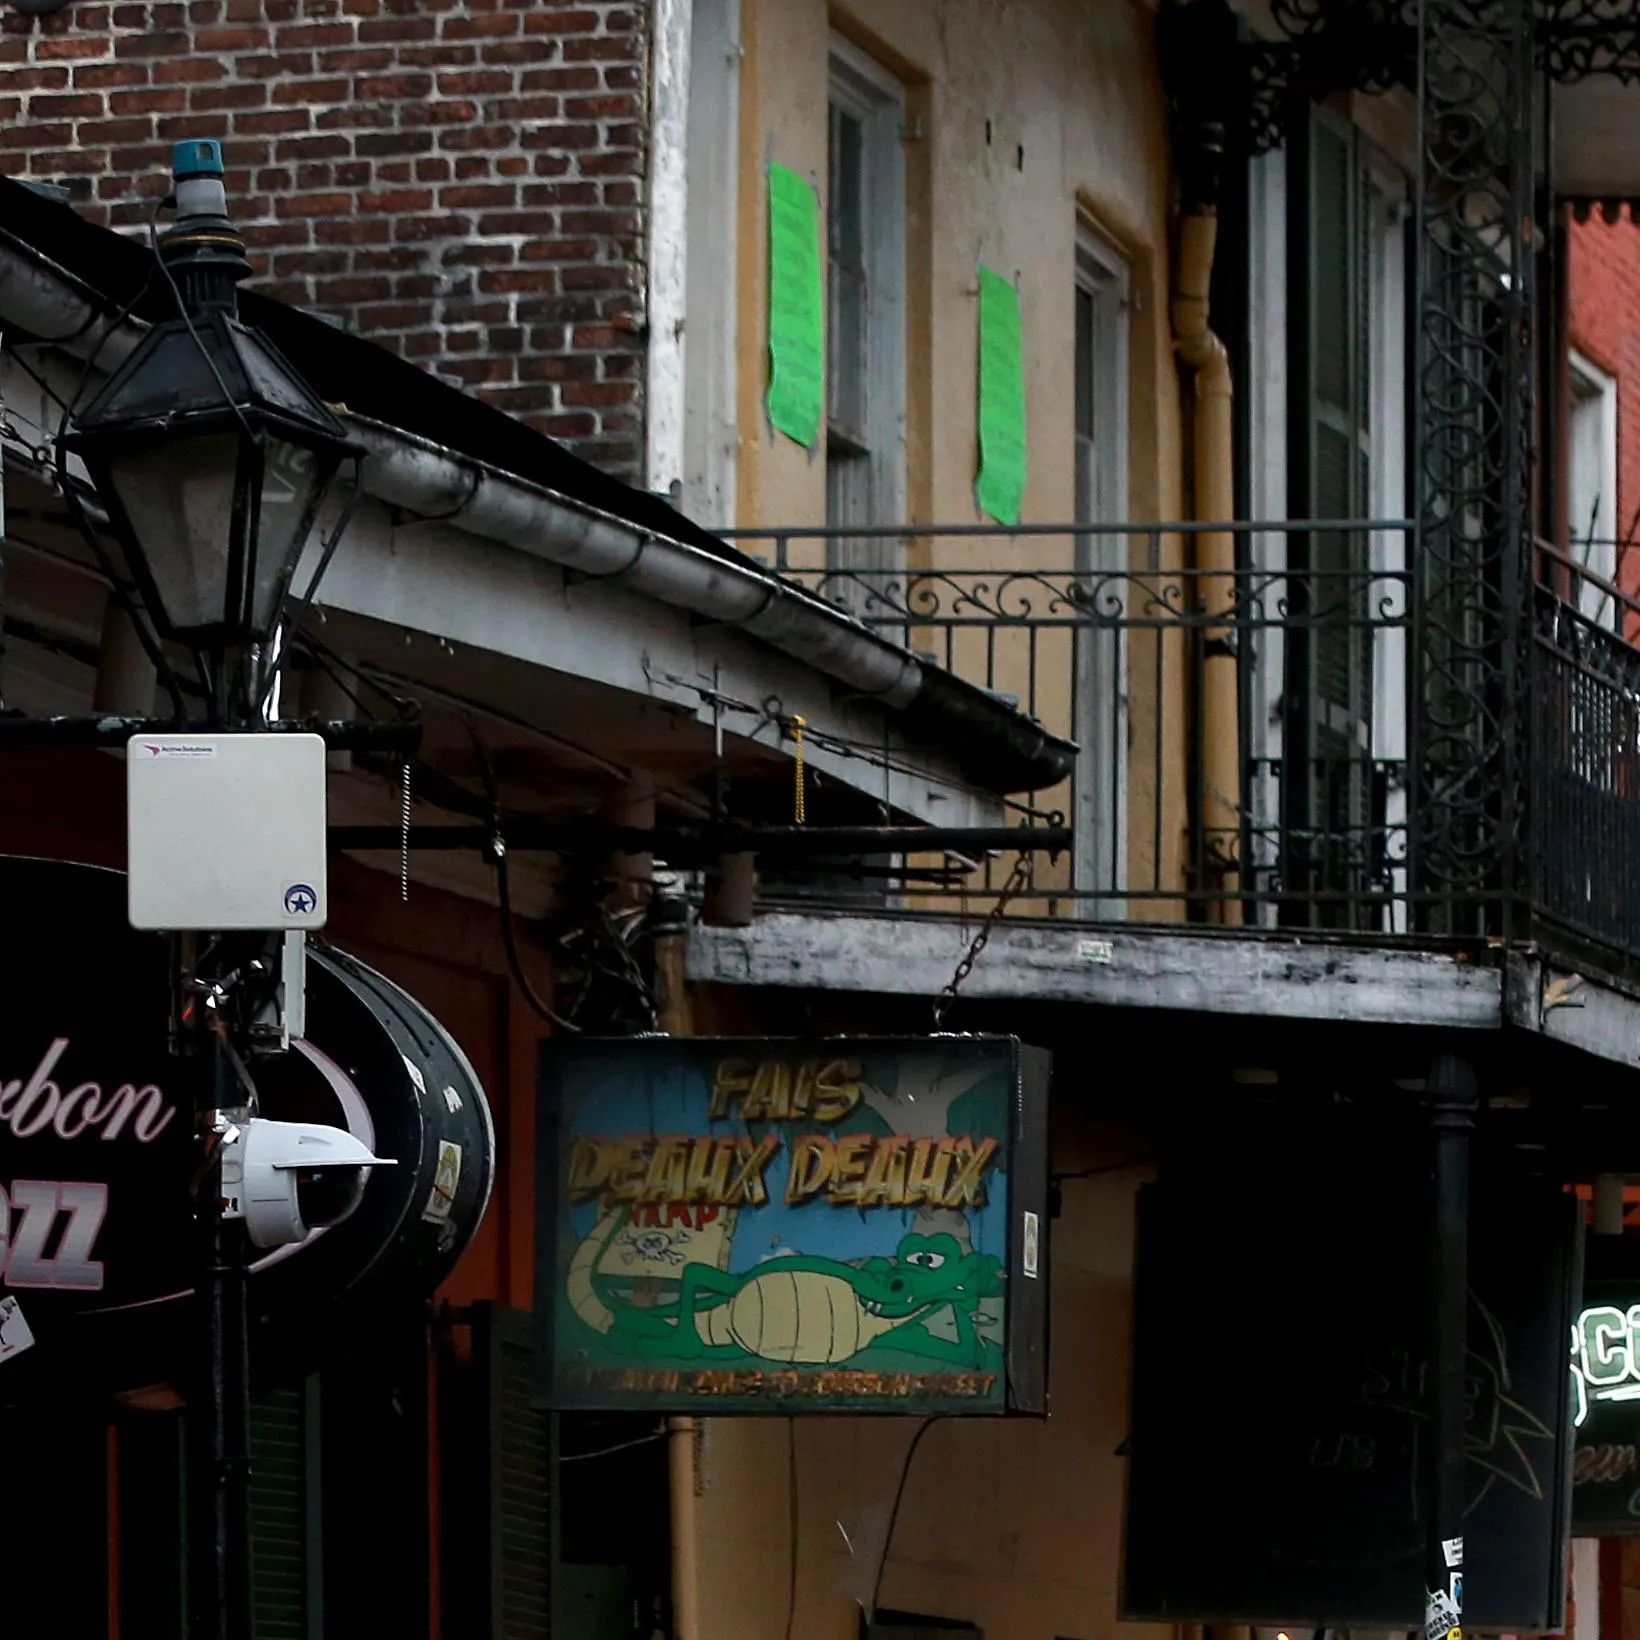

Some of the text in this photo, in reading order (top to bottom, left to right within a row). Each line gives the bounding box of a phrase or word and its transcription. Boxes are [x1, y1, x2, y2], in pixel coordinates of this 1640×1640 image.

[707, 1058, 863, 1122] FAIS
[569, 1134, 1000, 1207] DEAUX DEAUX
[1574, 1443, 1636, 1484] ew
